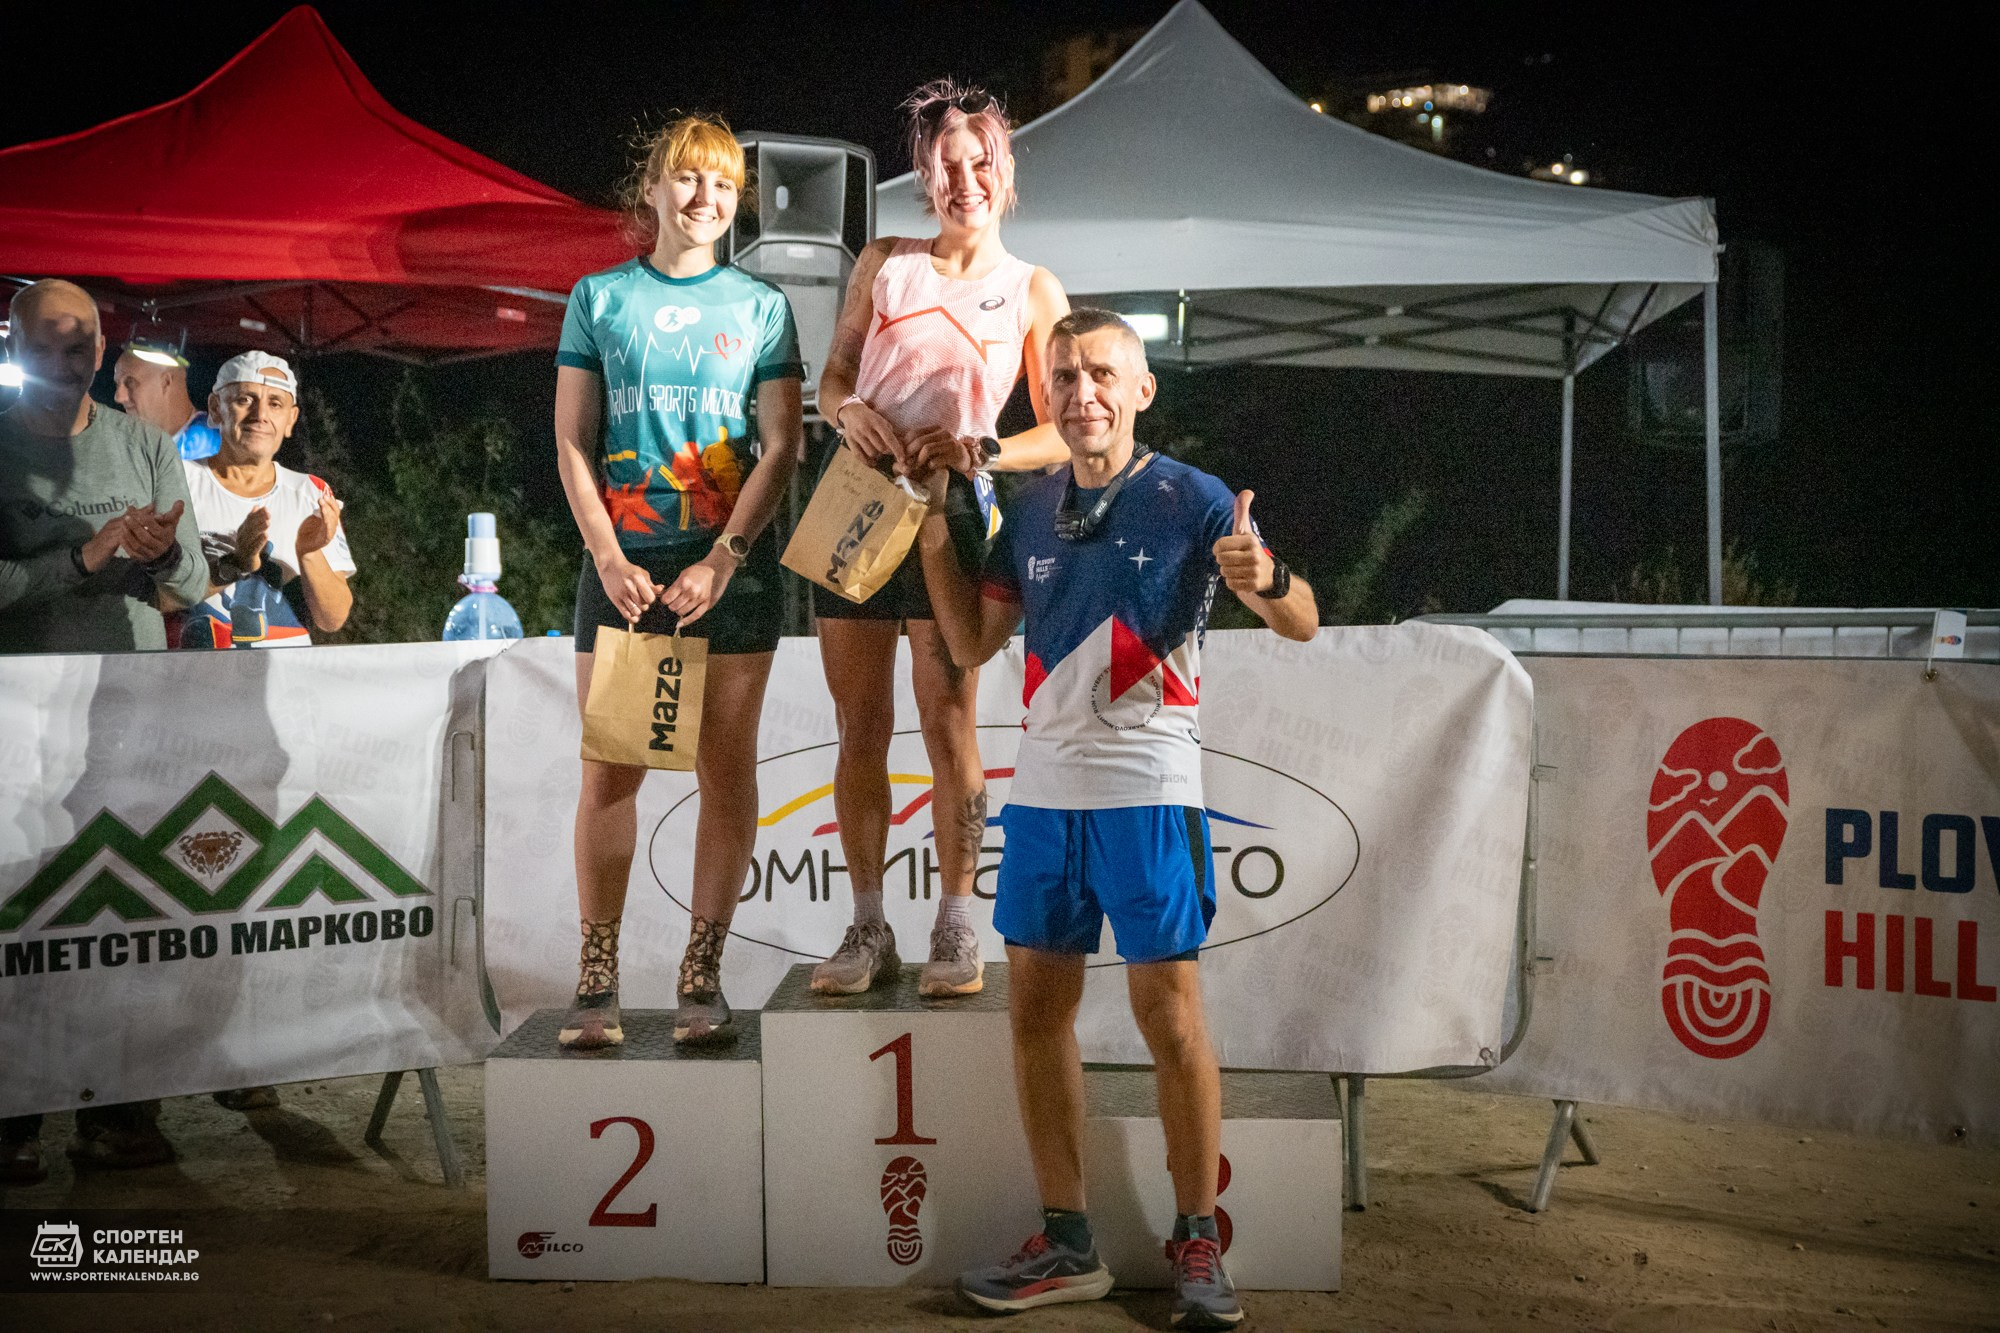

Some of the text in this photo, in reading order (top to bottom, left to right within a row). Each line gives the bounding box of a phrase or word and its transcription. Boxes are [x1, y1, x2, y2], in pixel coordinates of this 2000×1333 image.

[648, 384, 697, 422] SPORTS
[825, 498, 885, 584] Maze
[649, 656, 684, 753] Maze
[0, 924, 218, 977] МЕТСТВО
[231, 905, 433, 956] МАРКОВО
[1825, 910, 1997, 1003] HILL
[868, 1032, 938, 1146] 1
[588, 1117, 659, 1228] 2
[521, 1241, 584, 1253] MILCO
